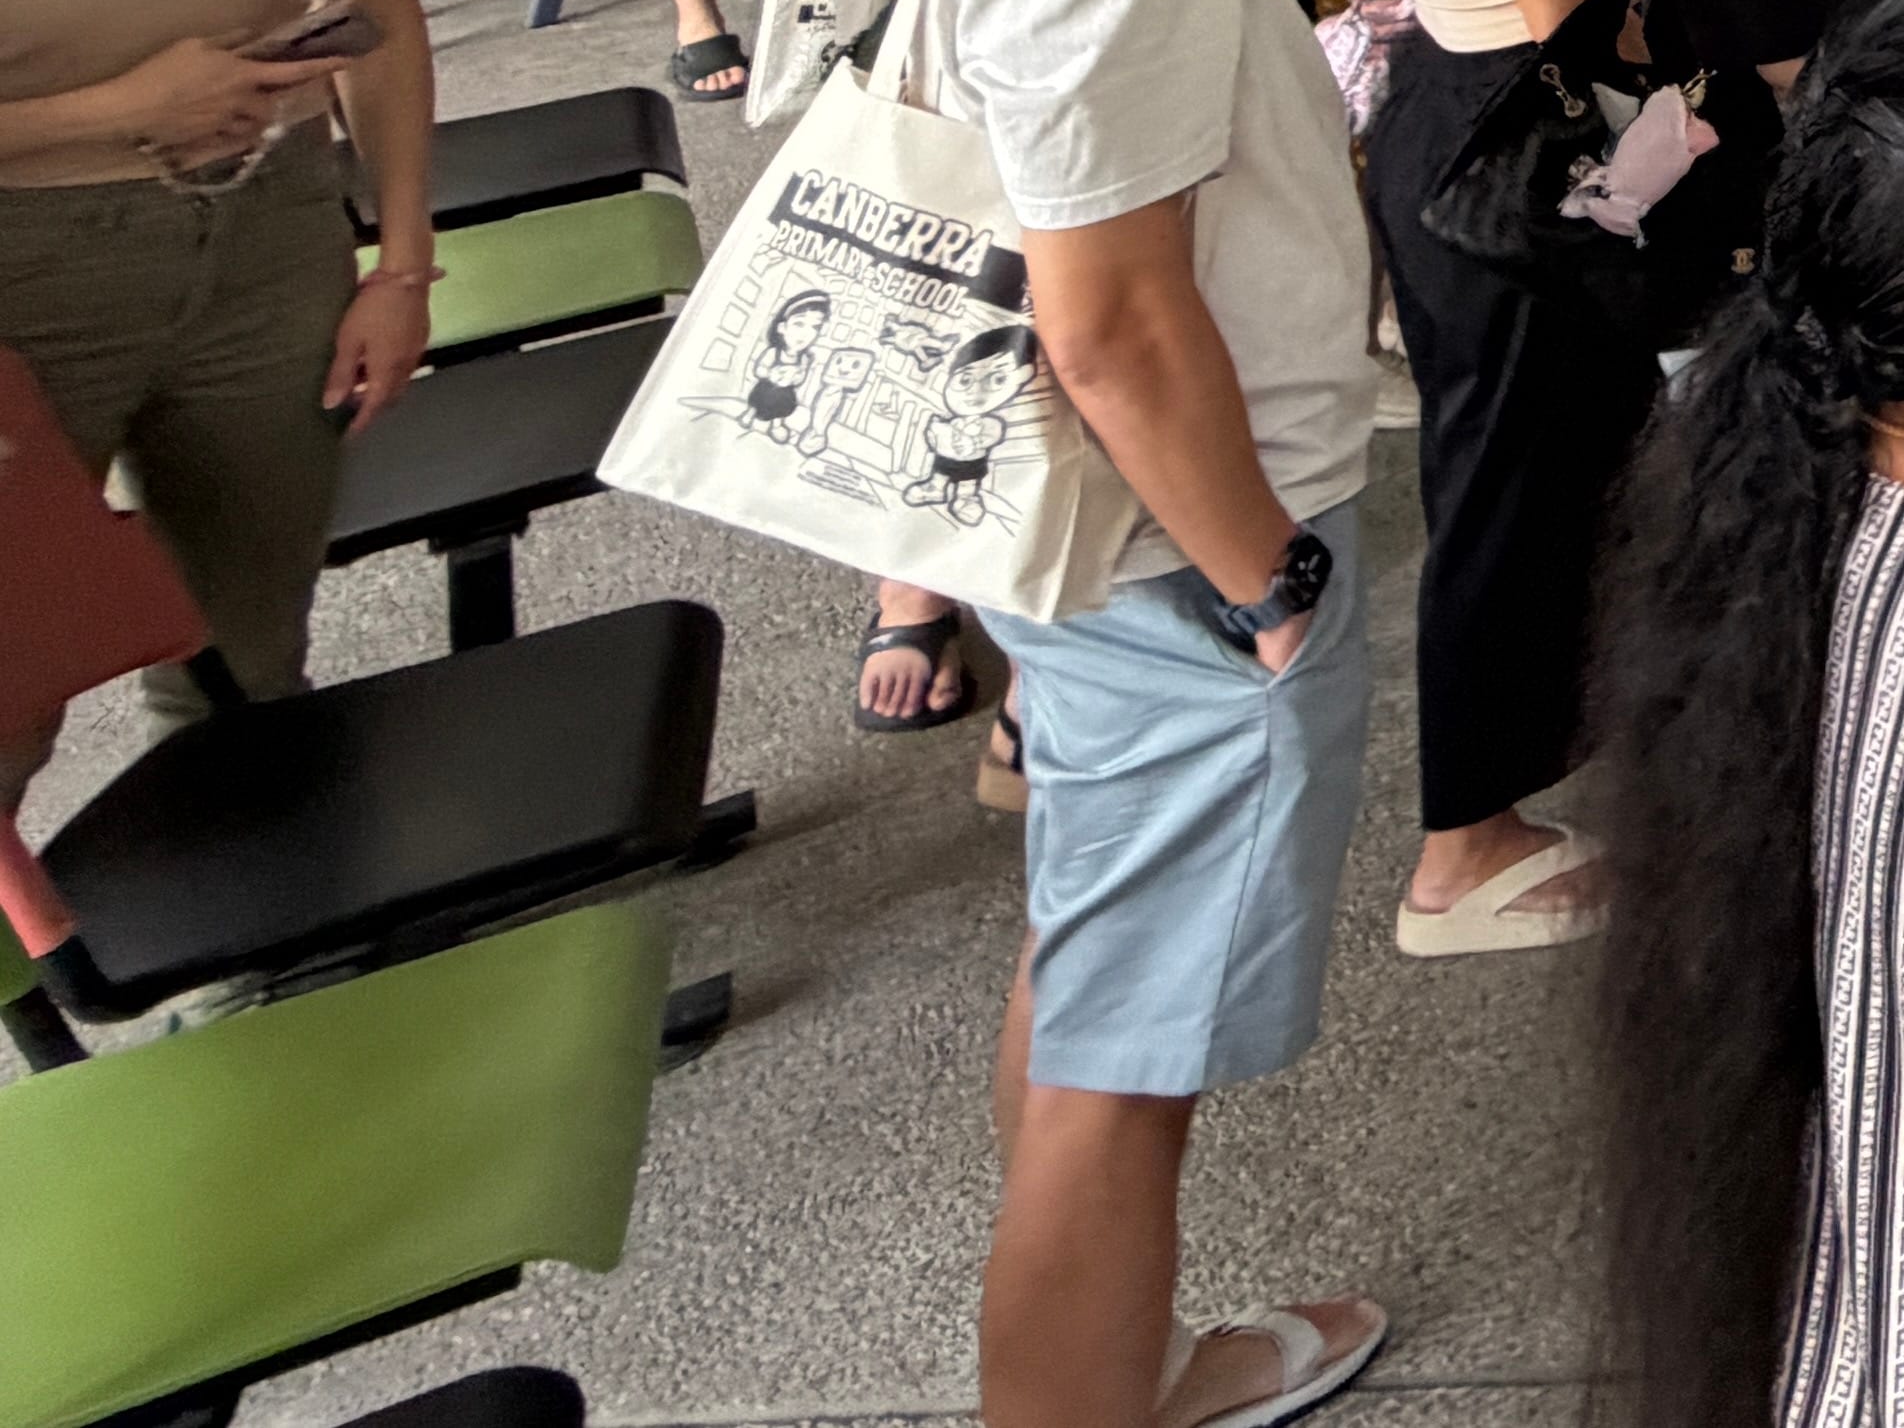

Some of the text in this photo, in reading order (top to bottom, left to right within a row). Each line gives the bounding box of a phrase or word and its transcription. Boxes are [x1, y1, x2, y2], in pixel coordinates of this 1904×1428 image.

[771, 219, 971, 318] PRIMARY SCHOOL
[790, 168, 993, 277] CANBERRA
